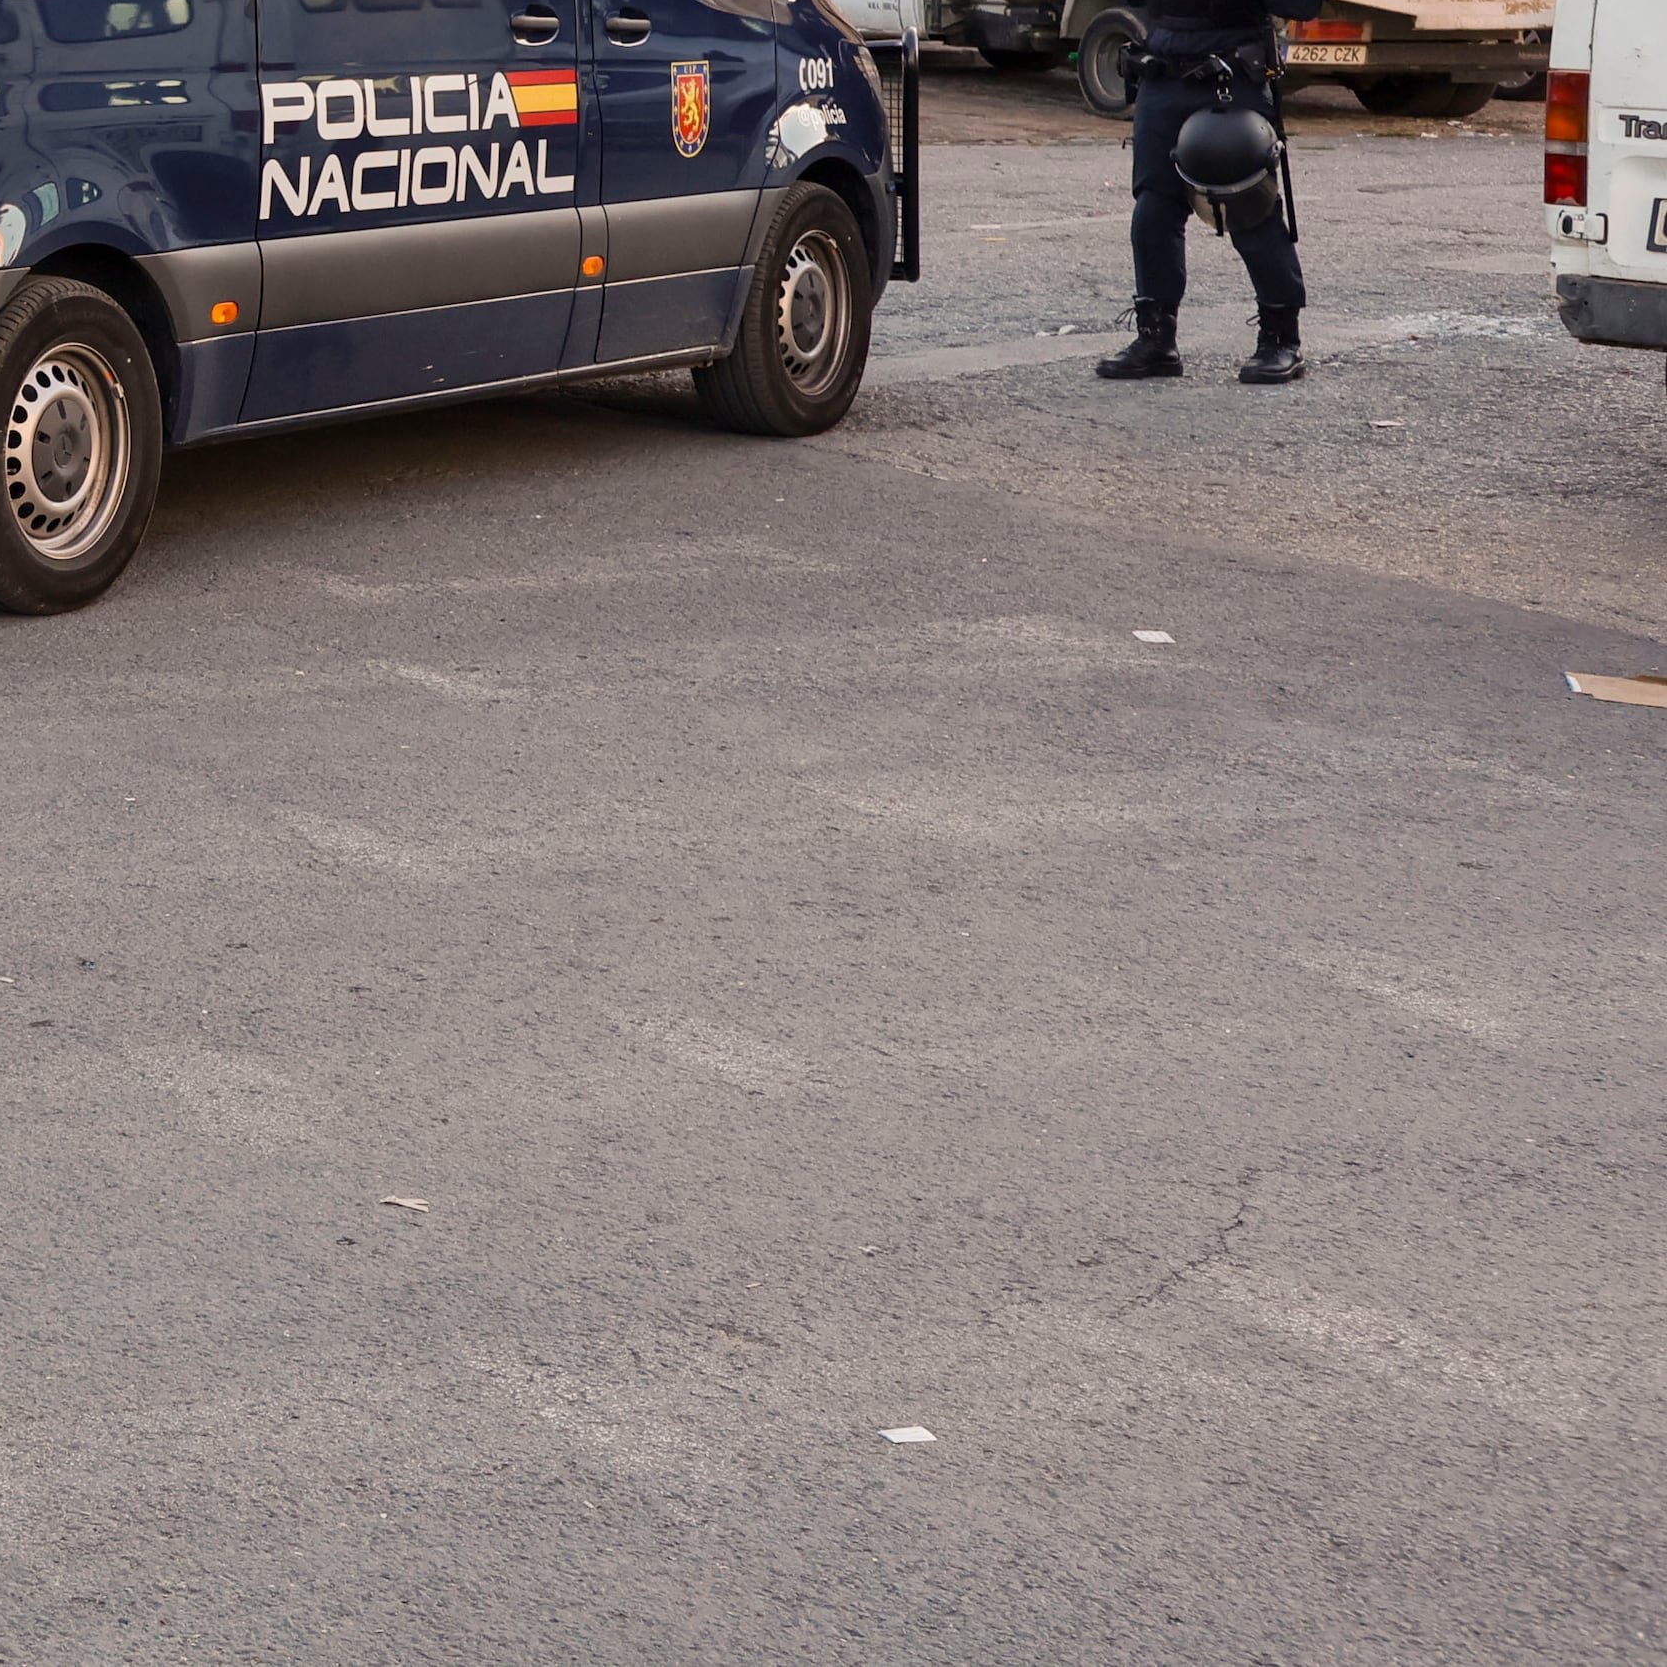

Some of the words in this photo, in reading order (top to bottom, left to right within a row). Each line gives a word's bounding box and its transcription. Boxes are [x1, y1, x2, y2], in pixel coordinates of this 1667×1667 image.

[1292, 46, 1328, 62] 4262
[1334, 47, 1361, 62] CZK
[1619, 114, 1667, 140] Tra
[259, 139, 574, 220] NACIONAL
